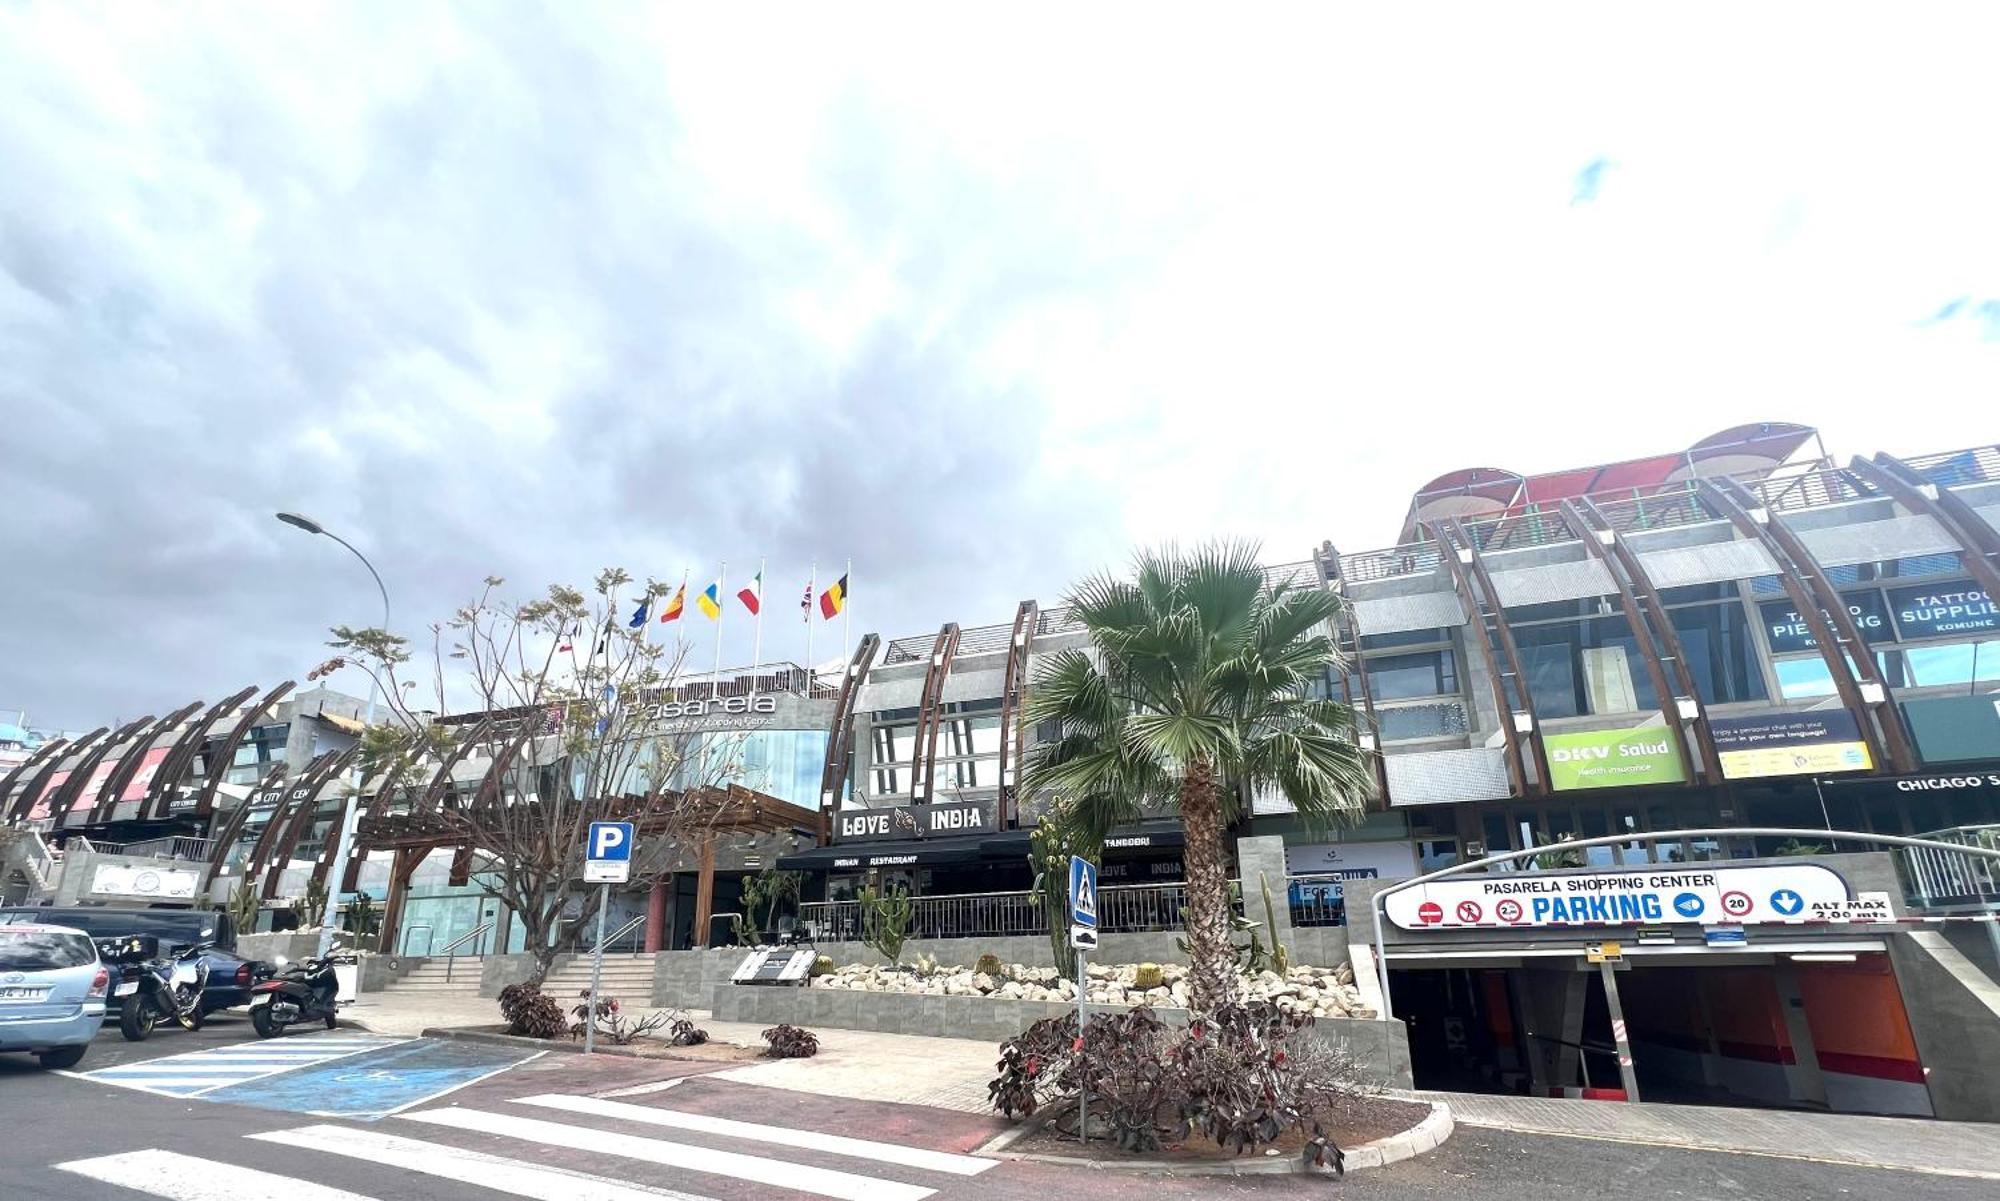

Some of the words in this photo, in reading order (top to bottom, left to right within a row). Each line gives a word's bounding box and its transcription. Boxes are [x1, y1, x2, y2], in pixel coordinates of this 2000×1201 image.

[1936, 619, 1995, 631] KOMUNE
[1739, 726, 1769, 735] personal
[1749, 734, 1767, 744] your
[1787, 728, 1828, 739] language!
[1552, 745, 1610, 762] DKV
[1619, 739, 1669, 757] Salud
[1608, 764, 1652, 774] insurance
[263, 791, 282, 802] CITY
[842, 814, 890, 836] LOVE
[931, 807, 981, 830] INDIA
[595, 827, 623, 857] P
[870, 855, 917, 866] RESTAURANT
[1151, 862, 1182, 874] INDIA
[1484, 880, 1560, 895] PASARELA
[1567, 876, 1644, 892] SHOPPING
[1649, 874, 1716, 888] CENTER
[1532, 893, 1663, 922] PARKING
[1728, 899, 1745, 909] 20
[1811, 901, 1843, 910] ALT
[1847, 900, 1887, 910] MAX
